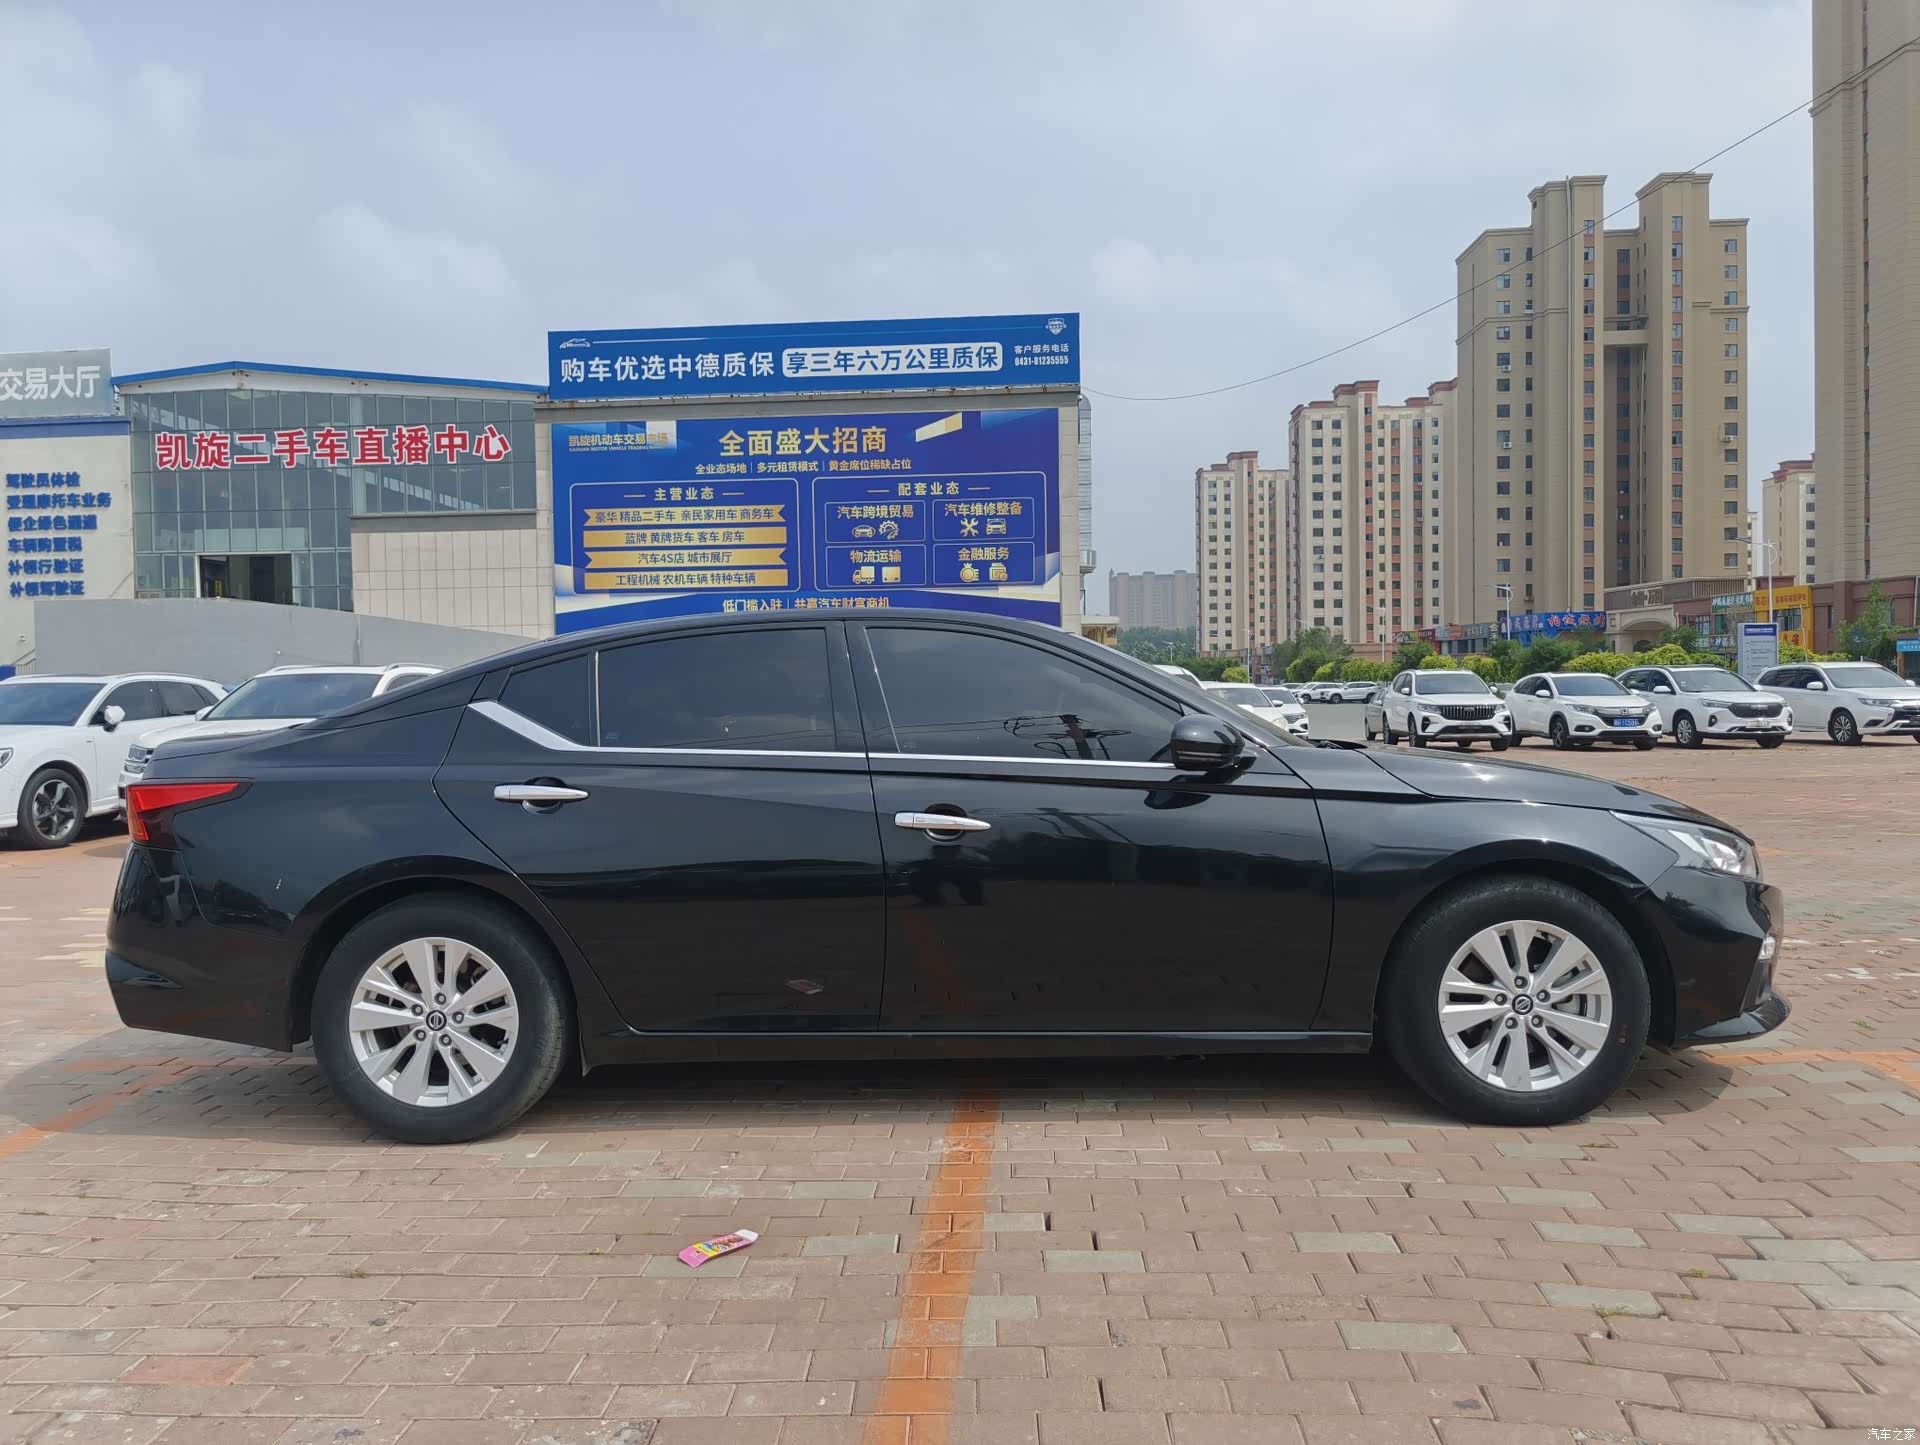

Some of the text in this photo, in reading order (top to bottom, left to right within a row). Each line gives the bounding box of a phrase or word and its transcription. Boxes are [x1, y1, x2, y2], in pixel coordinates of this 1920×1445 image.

[1014, 343, 1069, 354] 客户服务电话
[561, 344, 999, 383] 购车优选中德质保 享三年六万公里质保
[1014, 355, 1069, 366] 0431-81235555
[0, 365, 101, 401] 交易大厅
[568, 431, 668, 446] 凯旋机动车交易市场
[719, 426, 887, 457] 全面盛大招商
[154, 424, 511, 471] 凯旋二手车直播中心
[695, 458, 912, 475] 全业态场地 多元租赁模式 黄金席位稀缺占位
[654, 487, 714, 501] 主营业态
[898, 481, 959, 496] 配套业态
[620, 510, 676, 522] 精品二手车
[681, 509, 737, 521] 亲民家用车
[740, 508, 774, 520] 商务车
[837, 504, 914, 519] 汽车跨境贸易
[944, 501, 1023, 516] 汽车维修整备
[624, 530, 745, 544] 蓝牌 黄牌货车 客车 房车
[637, 551, 733, 564] 汽车4S店 城市展厅
[850, 549, 902, 563] 物流运输
[958, 547, 1010, 561] 金融服务
[615, 572, 756, 586] 工程机械 农机车辆 特种车辆
